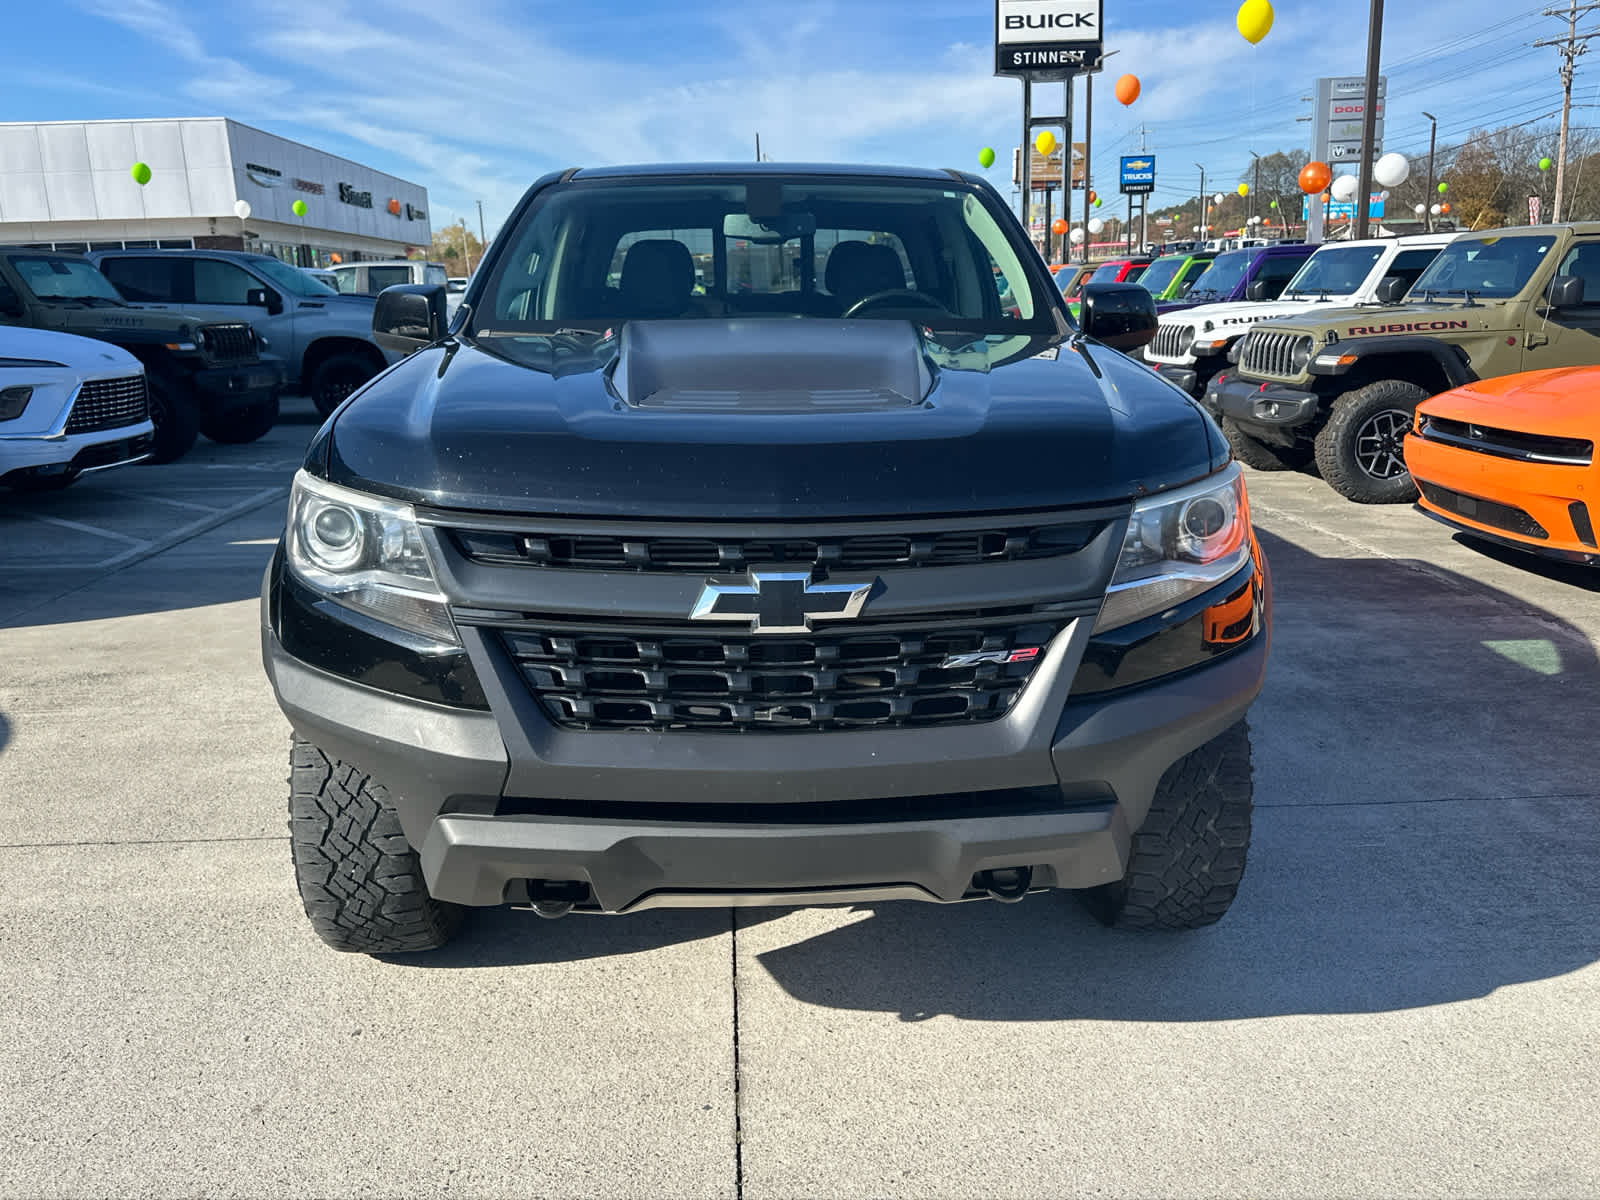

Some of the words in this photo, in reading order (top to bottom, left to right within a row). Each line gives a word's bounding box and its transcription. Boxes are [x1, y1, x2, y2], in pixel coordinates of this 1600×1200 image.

[1005, 13, 1095, 29] BUICK
[1013, 50, 1086, 64] STINNETT
[1334, 105, 1382, 113] DODE
[1348, 320, 1468, 336] RUBICON
[942, 647, 1039, 669] ZR2
